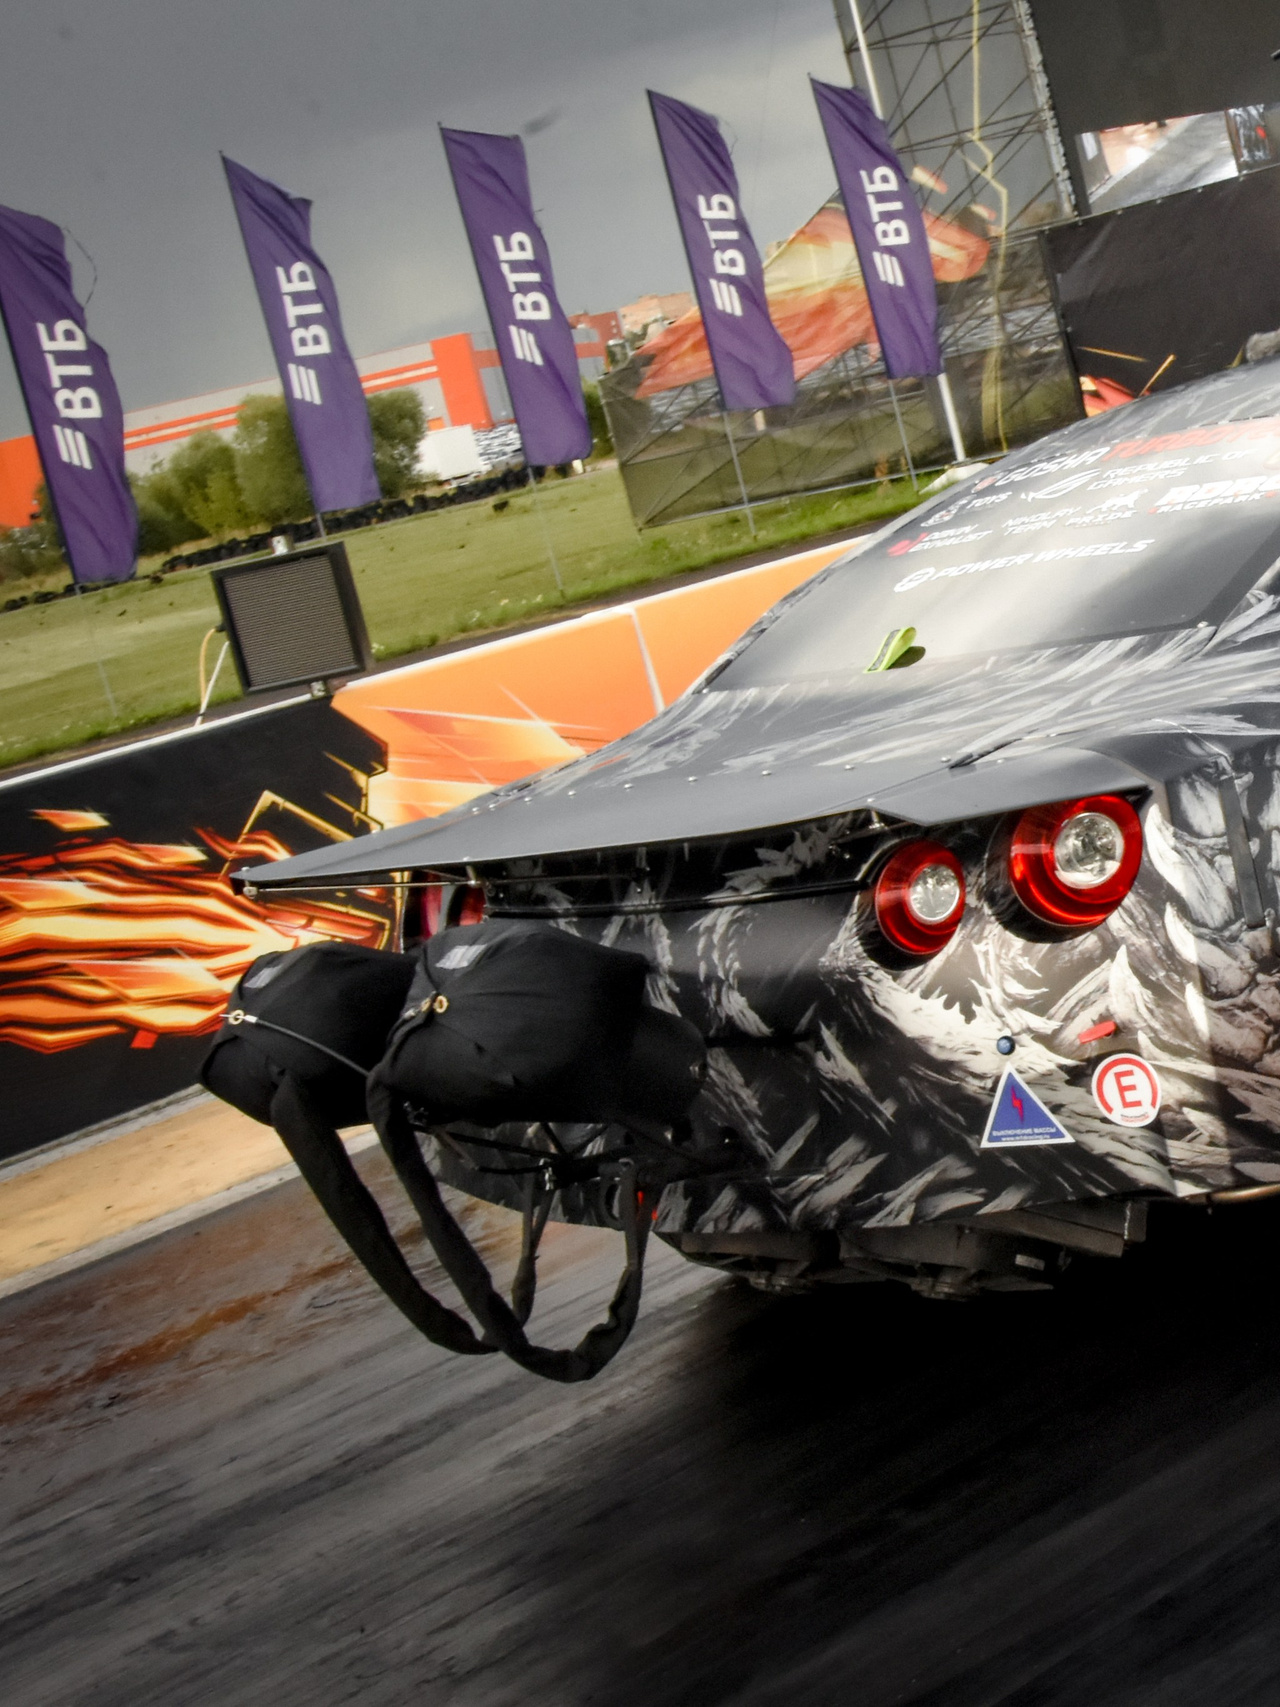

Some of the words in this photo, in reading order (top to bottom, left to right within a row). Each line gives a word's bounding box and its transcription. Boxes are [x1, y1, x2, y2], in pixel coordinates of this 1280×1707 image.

[860, 165, 911, 246] ВТБ
[698, 193, 747, 276] ВТБ
[493, 231, 551, 320] ВТБ
[276, 261, 332, 356] ВТБ
[36, 318, 103, 420] ВТБ
[995, 446, 1111, 487] GOSHA
[1086, 467, 1188, 491] GAMERS
[1102, 453, 1221, 479] REPUBLIC
[1065, 509, 1138, 527] PRIDE
[1157, 491, 1266, 514] RACEPARK
[930, 553, 1034, 580] POWER
[1031, 538, 1156, 564] WHEELS
[1113, 1069, 1143, 1109] E
